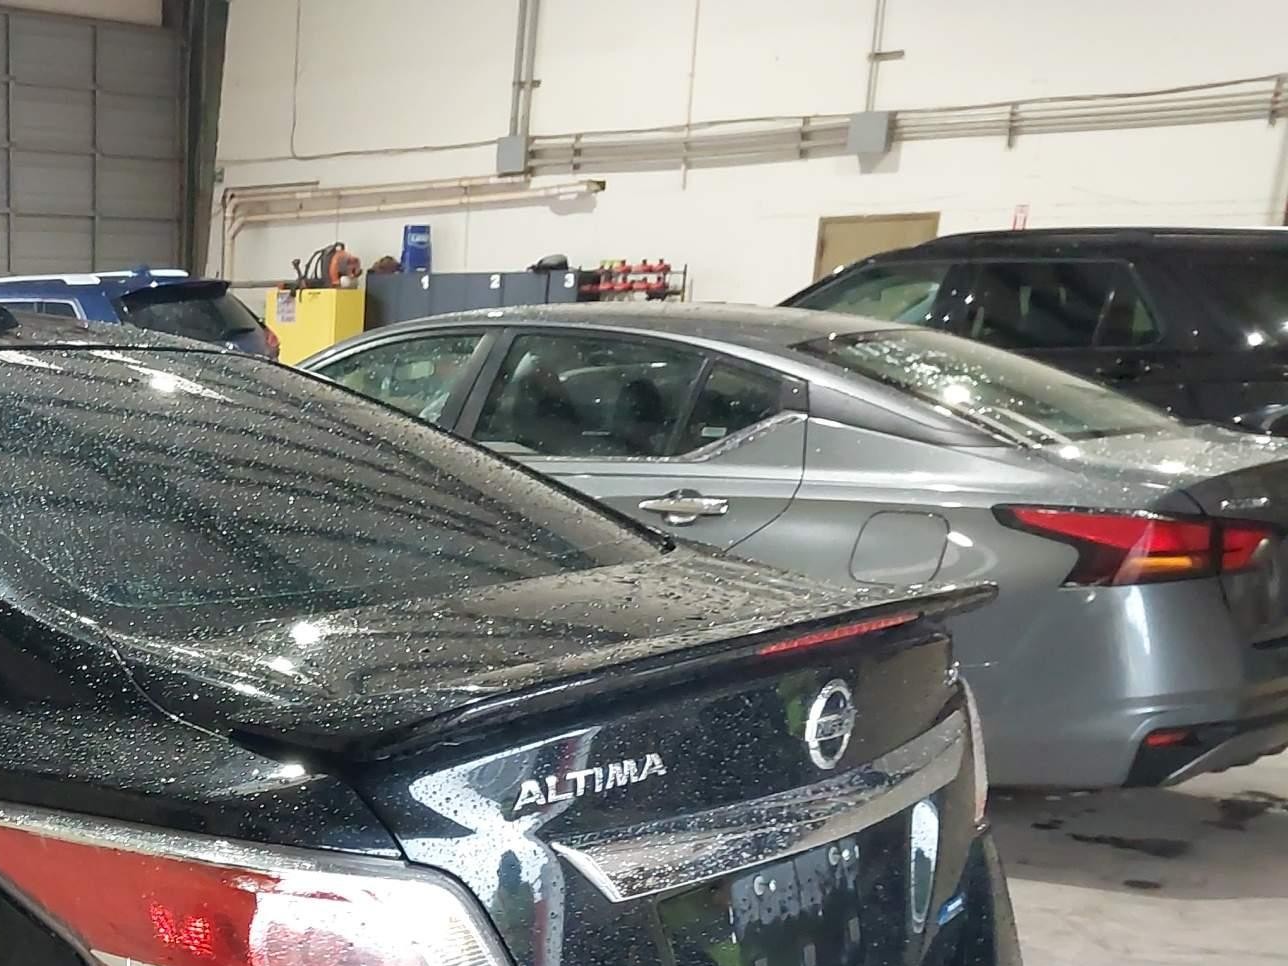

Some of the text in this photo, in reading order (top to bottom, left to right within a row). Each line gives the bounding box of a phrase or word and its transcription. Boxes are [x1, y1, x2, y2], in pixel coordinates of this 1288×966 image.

[421, 274, 430, 290] 1
[490, 274, 501, 289] 2
[564, 272, 575, 289] 3
[513, 753, 667, 811] ALTIMA
